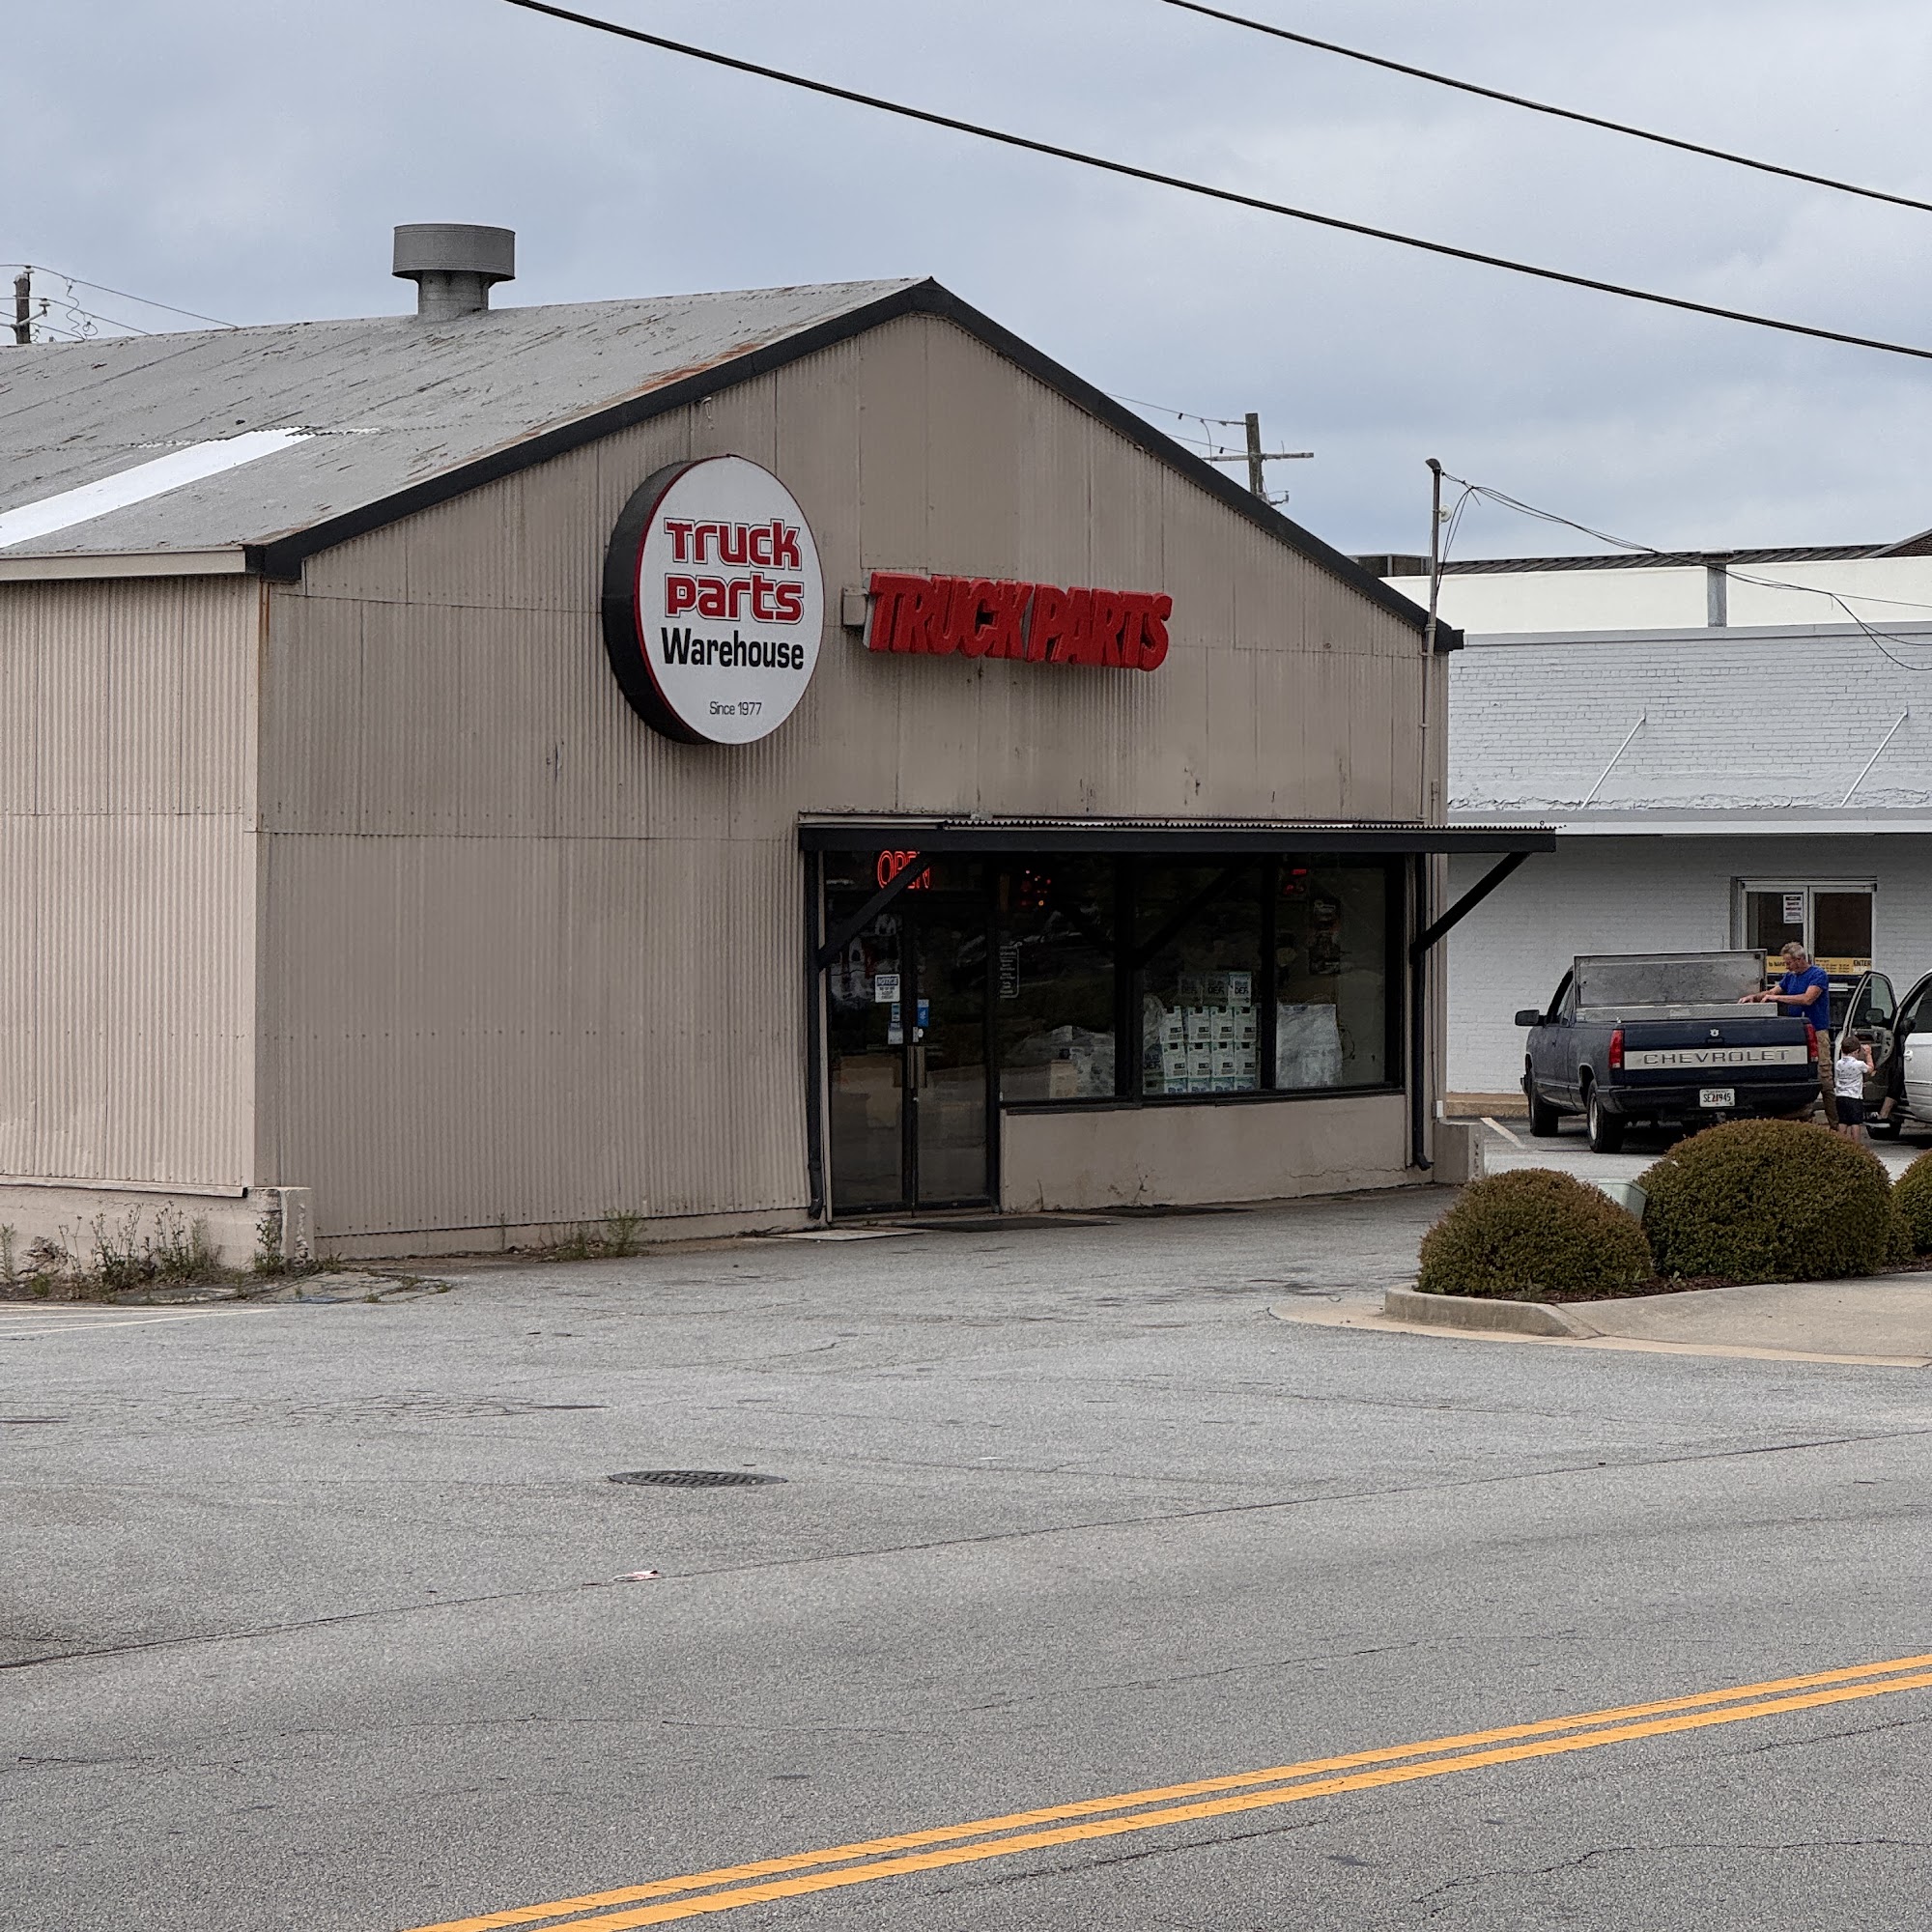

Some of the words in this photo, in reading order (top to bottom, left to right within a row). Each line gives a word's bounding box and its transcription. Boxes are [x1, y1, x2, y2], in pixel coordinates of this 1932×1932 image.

[665, 518, 802, 571] Truck
[869, 572, 1034, 660] TRUCK
[1026, 582, 1173, 672] PARTS
[661, 627, 804, 670] Warehouse
[709, 700, 735, 716] Since
[737, 701, 762, 717] 1977
[1643, 1049, 1789, 1065] CHEVROLET
